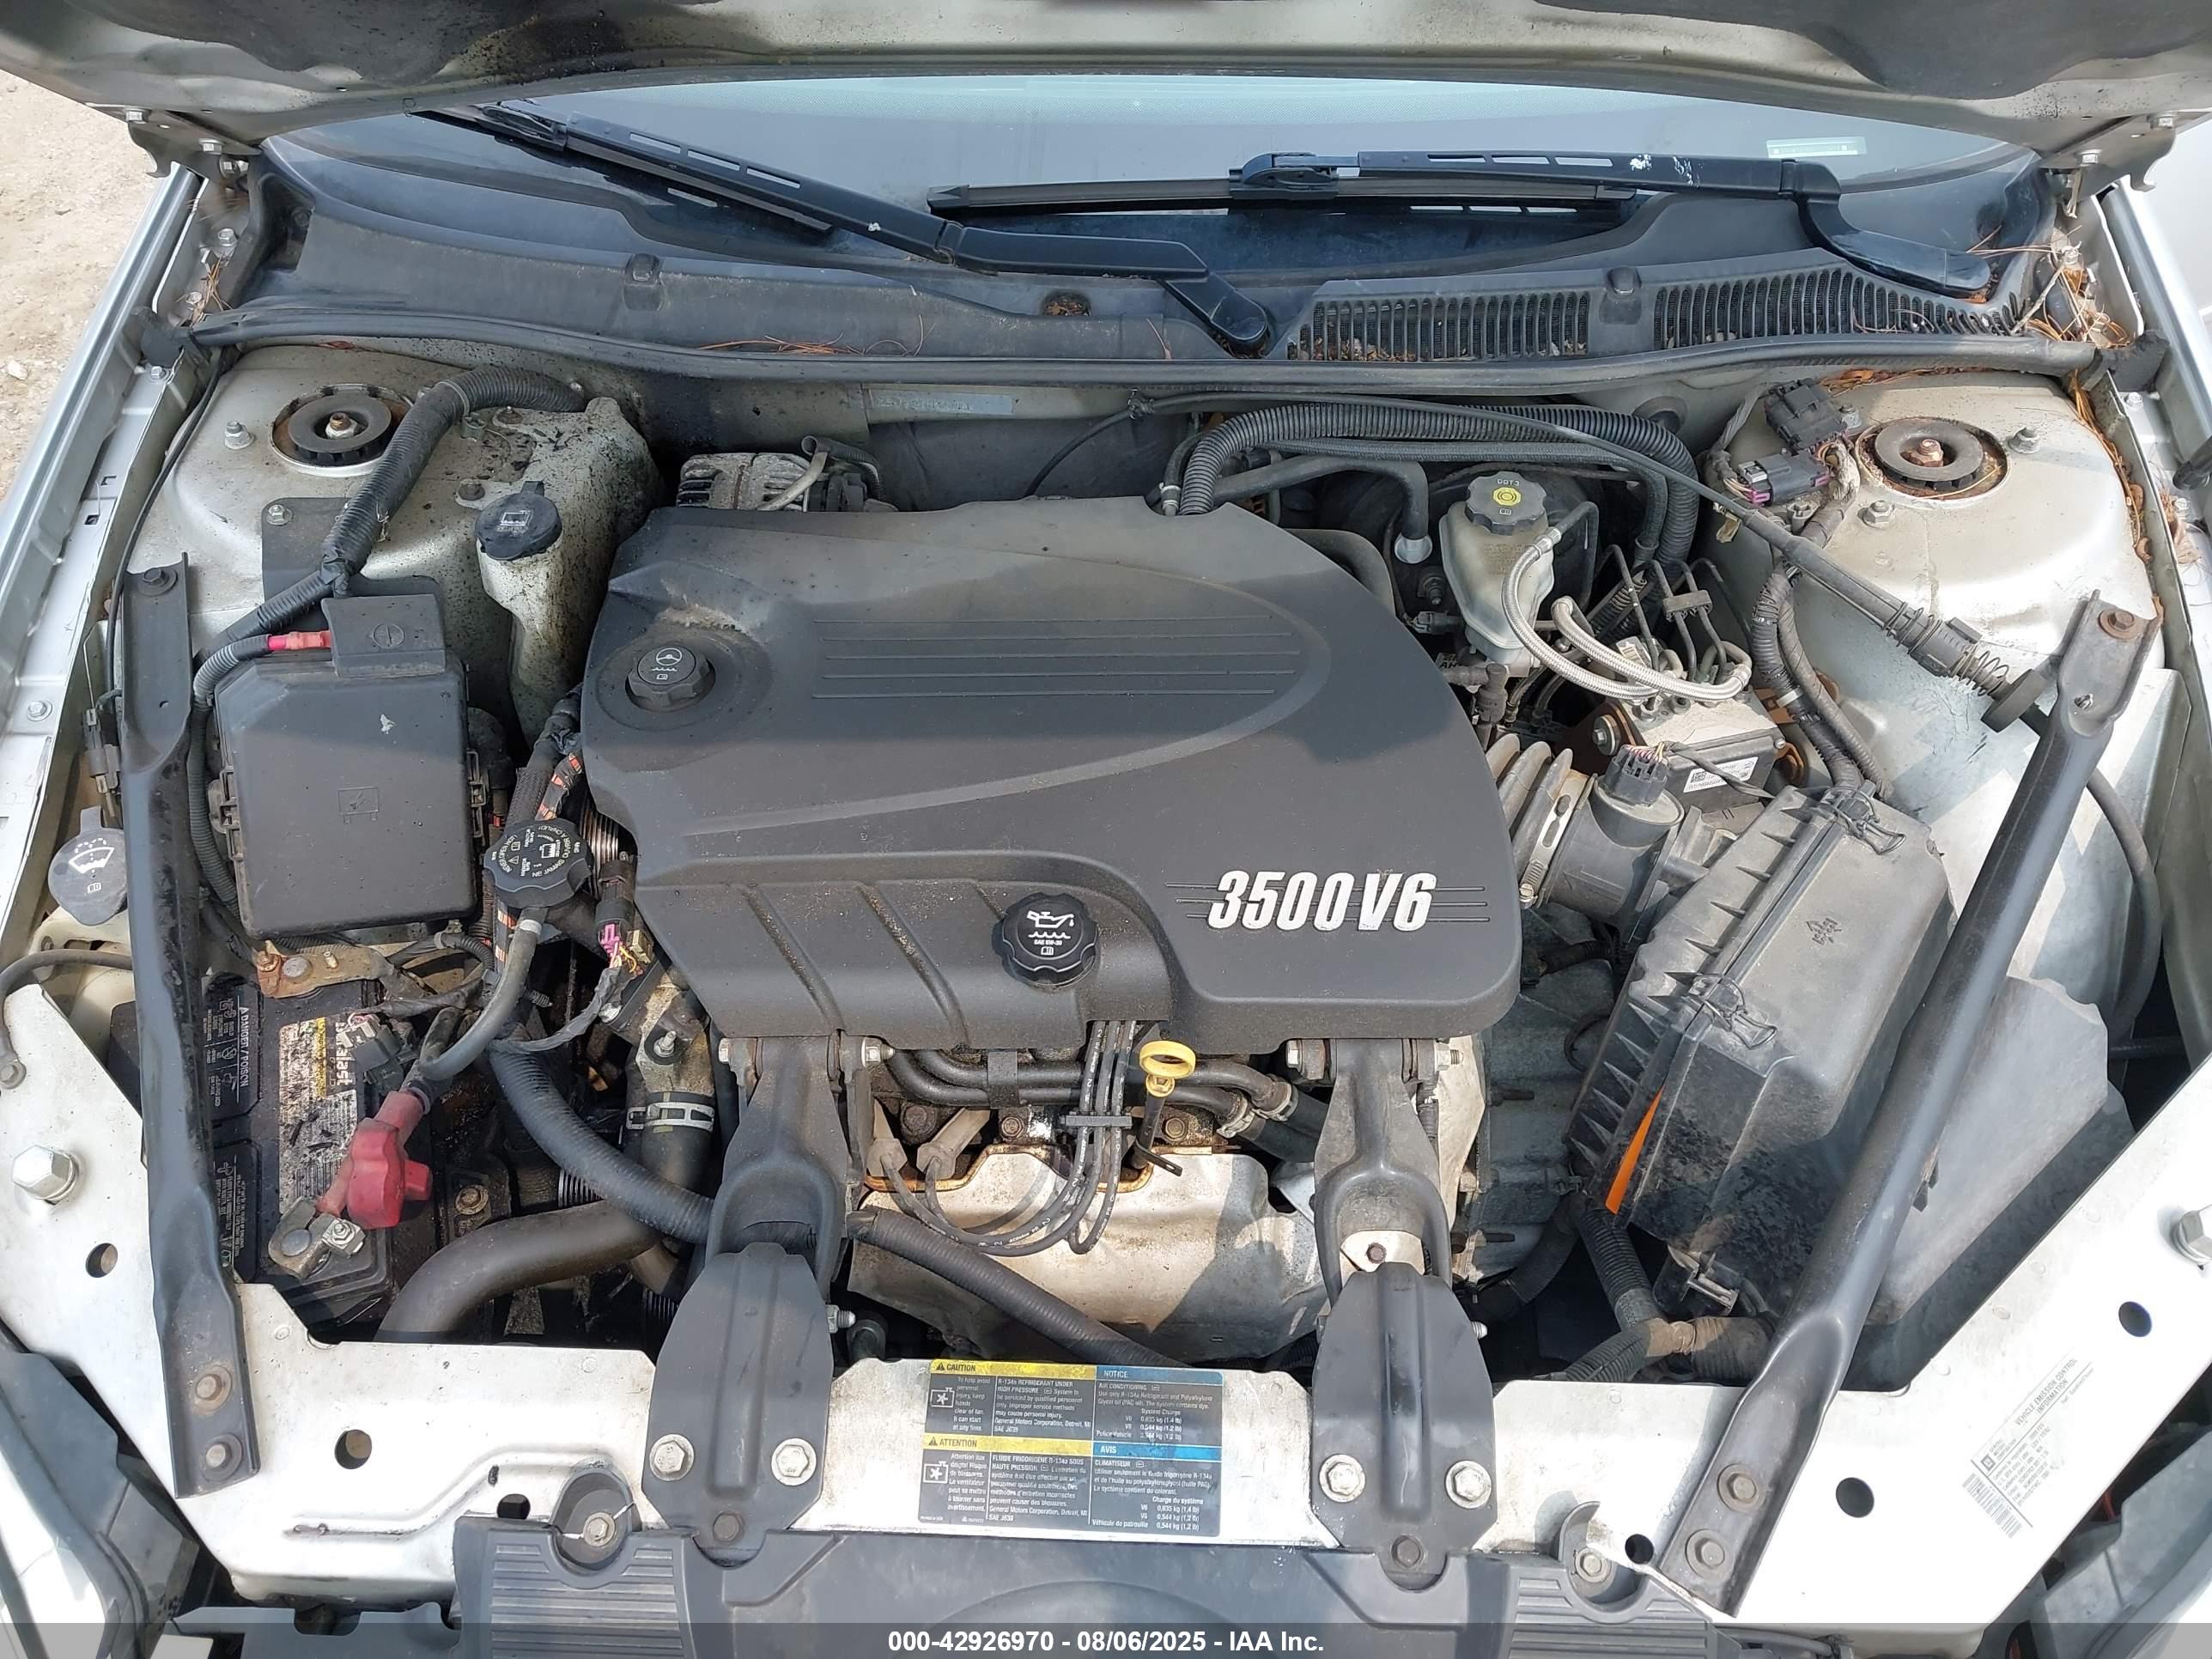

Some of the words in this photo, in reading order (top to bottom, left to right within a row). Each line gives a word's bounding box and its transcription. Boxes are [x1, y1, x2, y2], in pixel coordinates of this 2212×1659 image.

[1207, 870, 1355, 932] 3500
[1358, 872, 1437, 933] V6
[240, 1014, 249, 1048] DANGER
[240, 1055, 249, 1087] POISON
[336, 1022, 355, 1086] Dalast
[2014, 1402, 2036, 1425] VEHICLE
[2033, 1380, 2057, 1406] EMISSION
[2055, 1358, 2078, 1381] CONTROL
[2036, 1378, 2069, 1414] INFORMATION
[939, 1438, 977, 1447] ATTENTION
